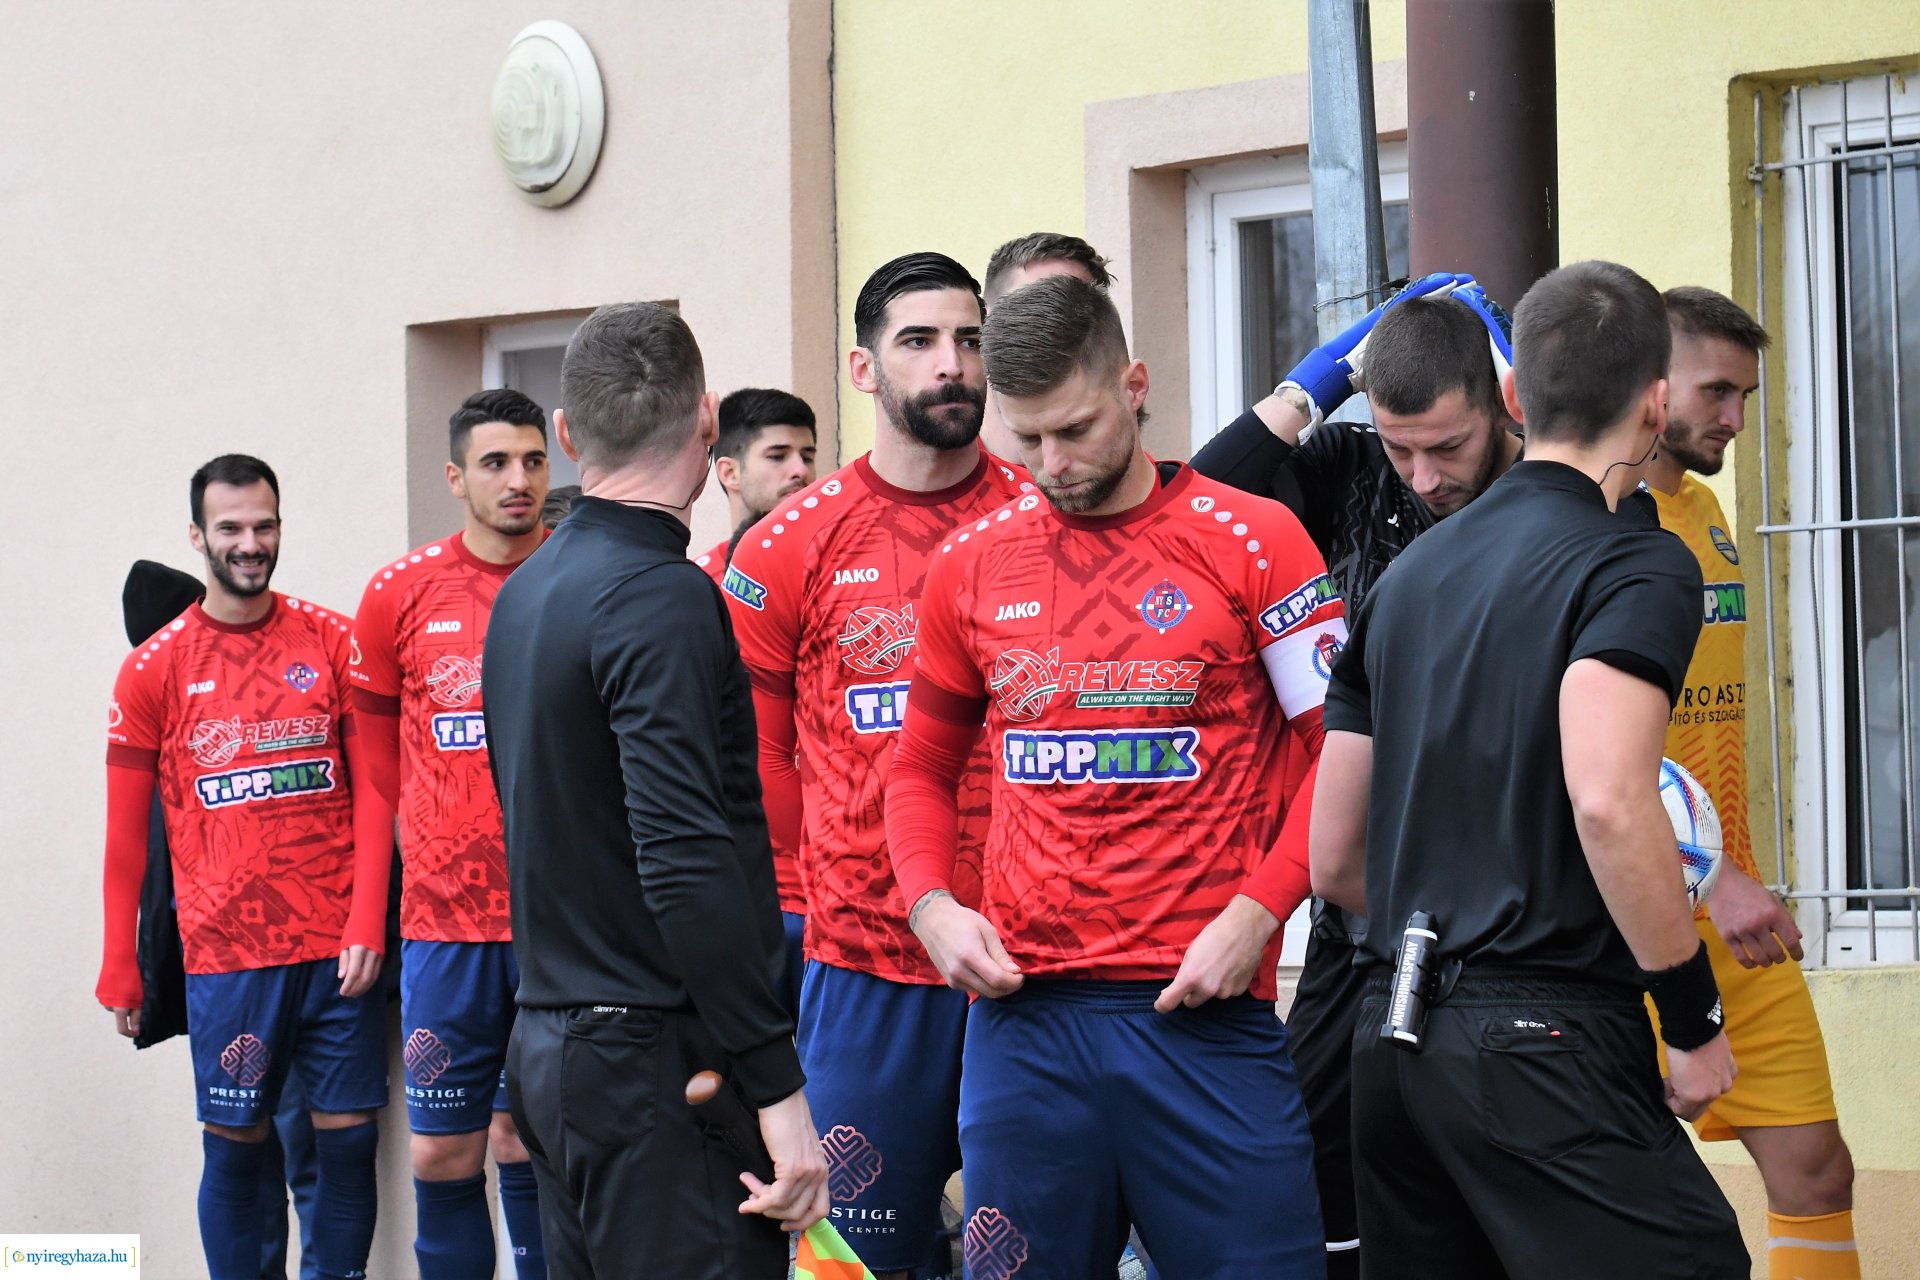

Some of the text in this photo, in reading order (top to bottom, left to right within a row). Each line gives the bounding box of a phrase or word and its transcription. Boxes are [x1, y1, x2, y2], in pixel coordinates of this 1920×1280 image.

[833, 568, 879, 585] JAKO
[994, 601, 1041, 621] JAKO
[426, 621, 461, 634] JAKO
[1058, 660, 1205, 691] REVESZ
[187, 680, 215, 697] JAKO
[1080, 693, 1191, 704] ALWAYS ON THE RIGHT WAY
[241, 714, 331, 744] REVESZ
[1391, 940, 1418, 1027] VANISHING SPRAY
[831, 1206, 897, 1220] STIGE
[848, 1226, 896, 1234] CENTER
